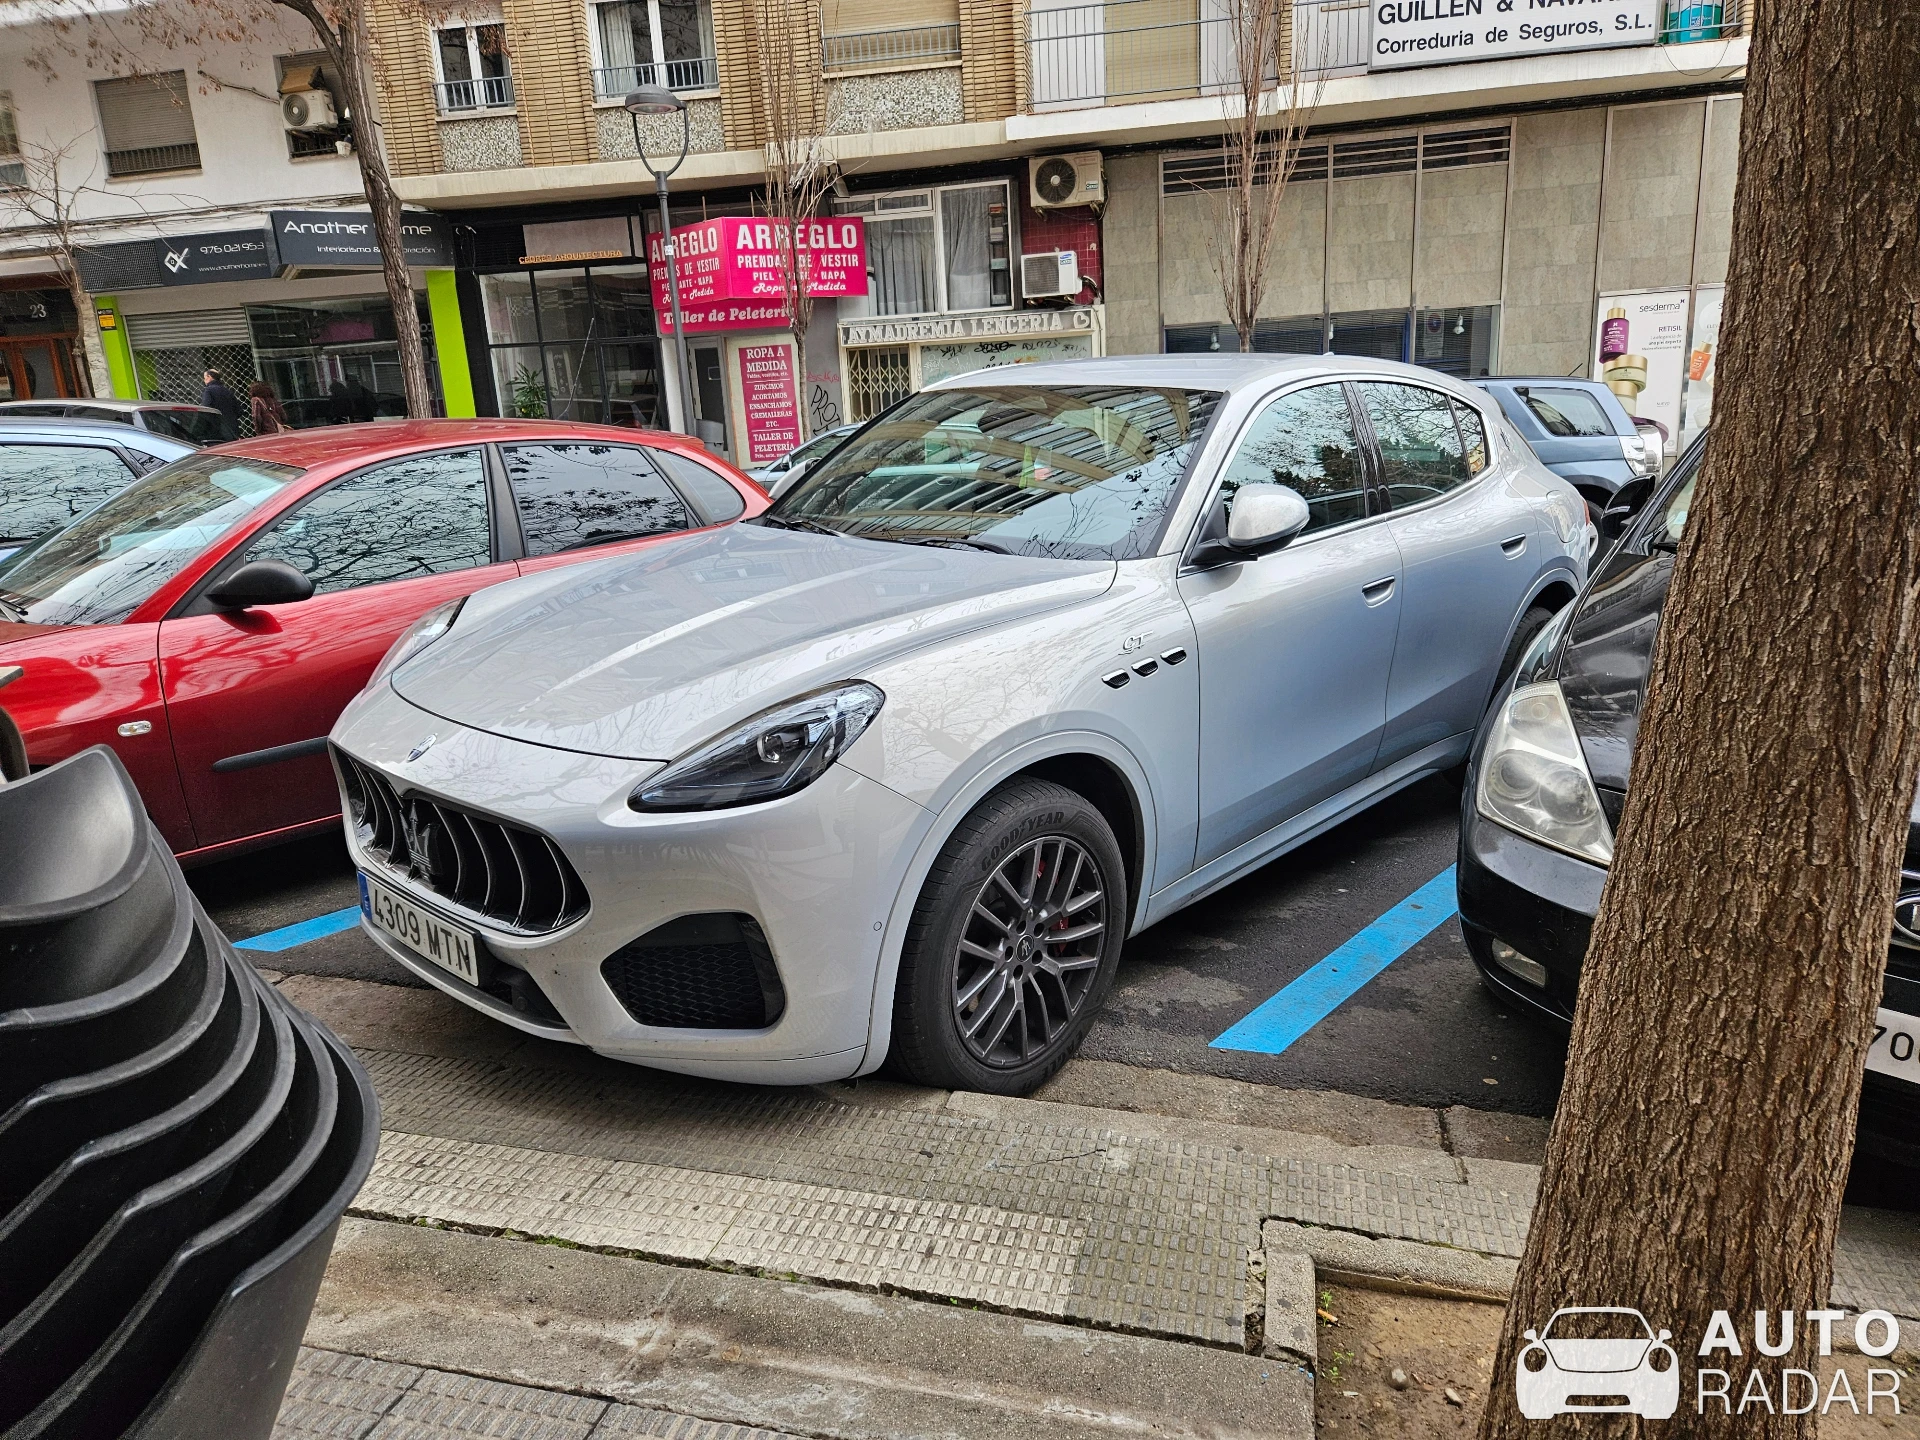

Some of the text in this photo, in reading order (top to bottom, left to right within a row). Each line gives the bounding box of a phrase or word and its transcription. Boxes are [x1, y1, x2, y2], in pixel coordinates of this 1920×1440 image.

[1376, 13, 1652, 55] Correduria de Seguros, S.L.
[284, 220, 368, 235] Another
[736, 224, 858, 249] ARREGLO
[200, 246, 222, 255] 976
[316, 245, 372, 253] Interiorismo
[555, 249, 623, 261] ARQUITECTURA
[684, 262, 693, 275] DE
[697, 257, 720, 273] VESTIR
[798, 254, 812, 268] DE
[821, 254, 859, 267] VESTIR
[753, 271, 774, 281] PIEL
[820, 271, 846, 280] NAPA
[662, 282, 671, 292] PIE
[697, 275, 713, 285] NAPA
[806, 282, 846, 293] Medida
[689, 287, 714, 300] Medida
[30, 303, 47, 318] 23
[1639, 303, 1681, 312] sesderma
[708, 309, 726, 322] de
[970, 312, 1063, 336] LENCERIA
[746, 346, 785, 359] ROPA A
[746, 360, 787, 373] MEDIDA
[754, 383, 784, 391] ZURCIMOS
[751, 392, 788, 401] ACORTAMOS
[749, 401, 792, 410] ENSANCHAMOS
[750, 410, 793, 419] CREMALLERAS
[765, 420, 780, 428] ETC.
[753, 432, 794, 441] TALLER DE
[754, 441, 795, 453] PELETERÍA
[1119, 630, 1154, 655] GT
[374, 888, 472, 977] 4309 MTN
